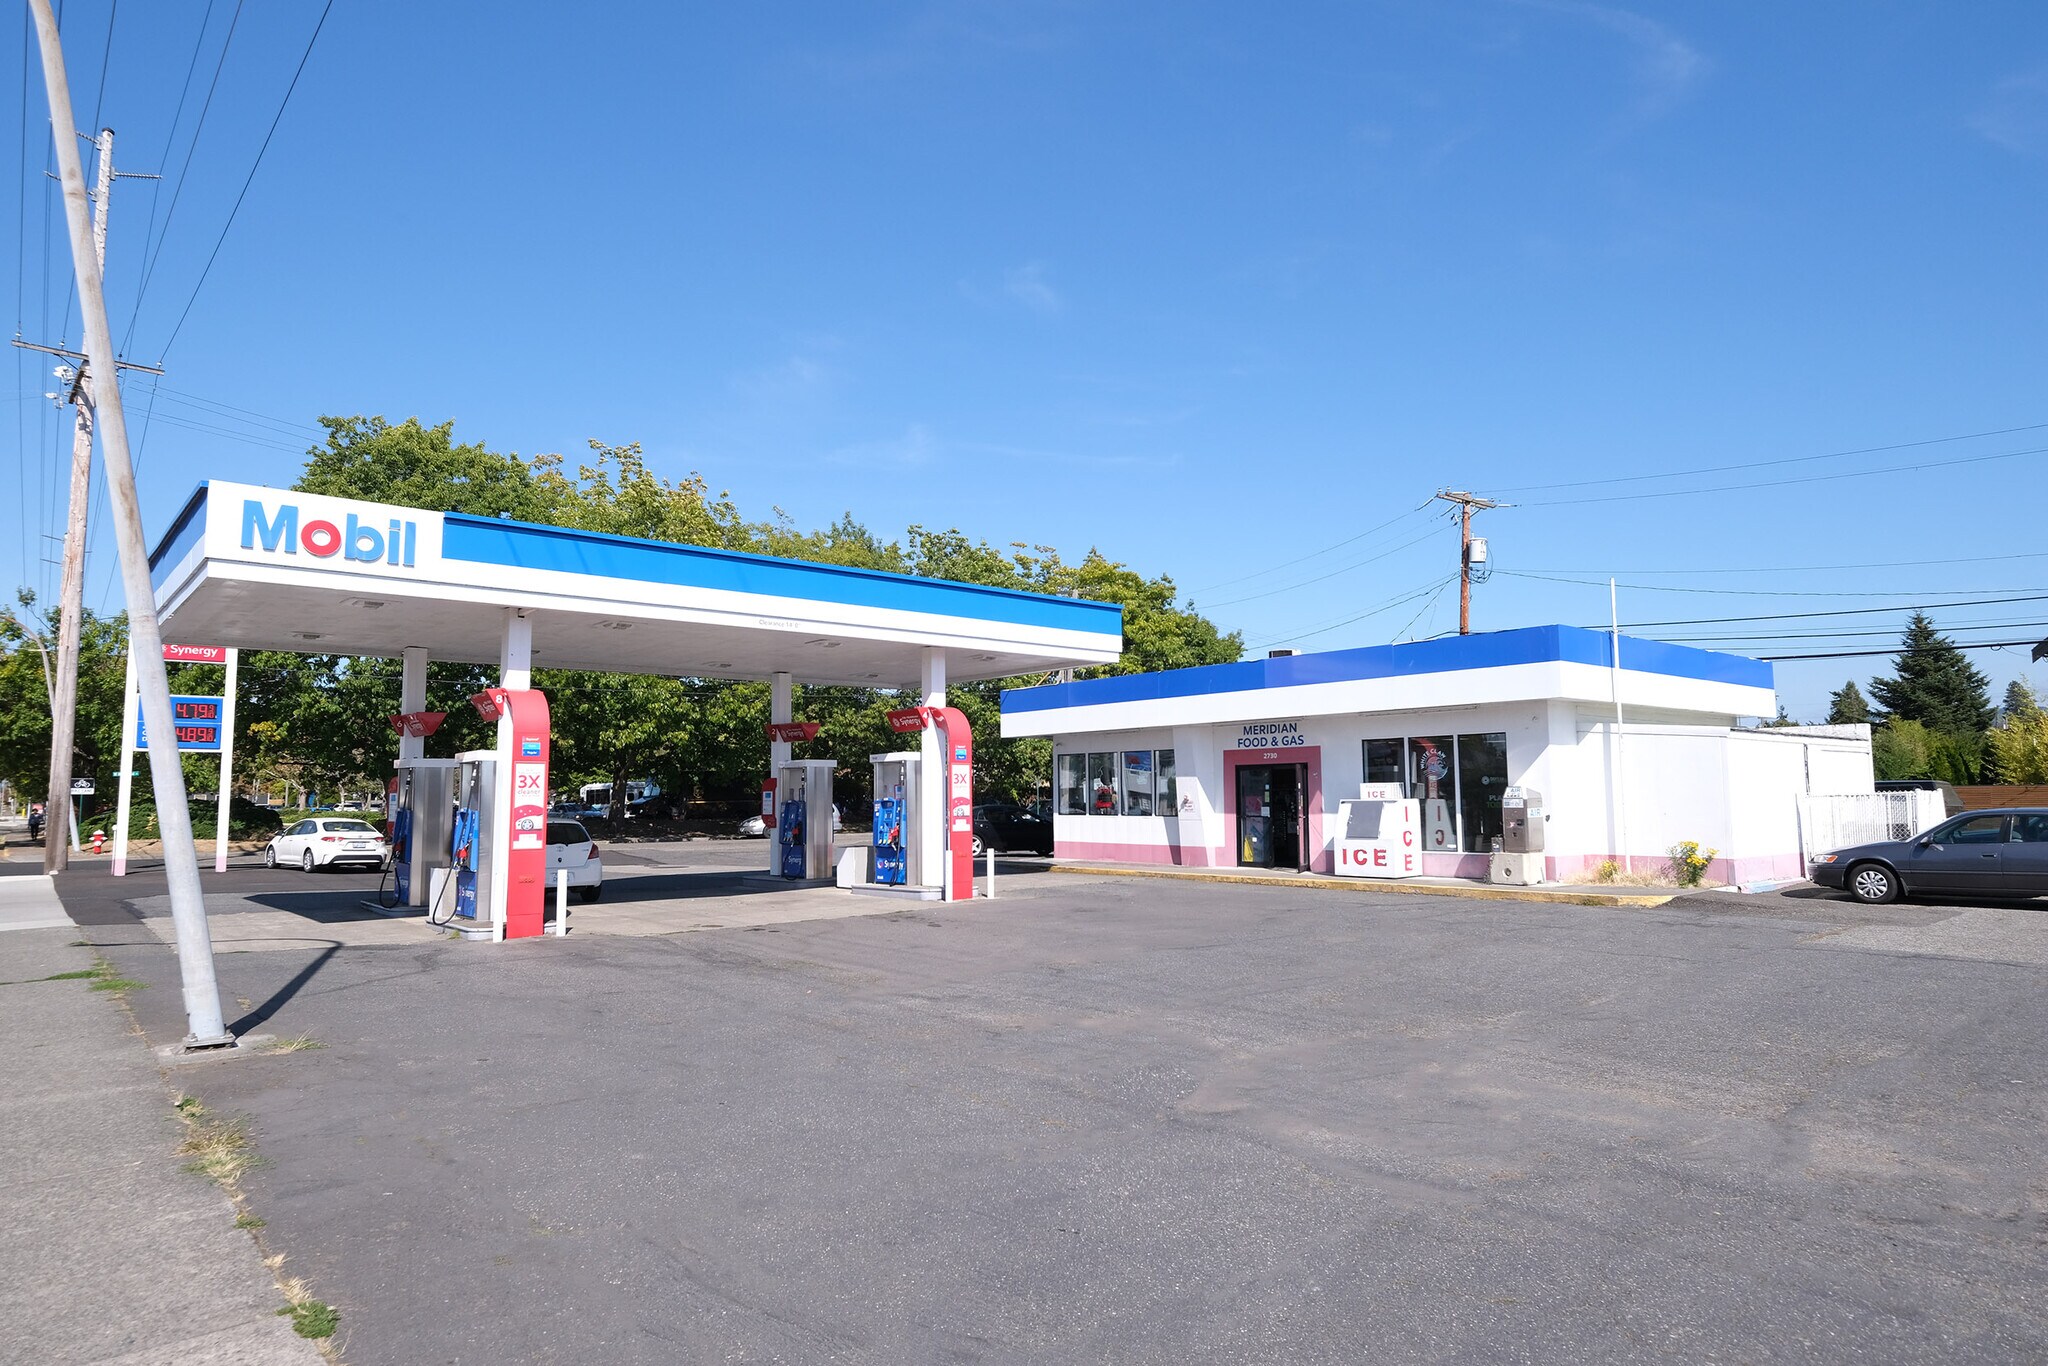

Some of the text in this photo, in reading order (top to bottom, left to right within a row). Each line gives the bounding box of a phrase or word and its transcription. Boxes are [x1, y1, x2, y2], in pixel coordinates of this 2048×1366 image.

[240, 499, 417, 568] Mobil
[170, 644, 218, 657] Synergy
[495, 694, 503, 703] 8
[1243, 723, 1297, 735] MERIDIAN
[1237, 735, 1305, 748] FOOD & GAS
[1420, 748, 1446, 770] WHITE CLAW
[518, 775, 540, 789] 3X
[953, 773, 967, 784] 3X
[1530, 808, 1542, 816] AIR
[1403, 805, 1413, 871] ICE
[1342, 848, 1387, 867] ICE
